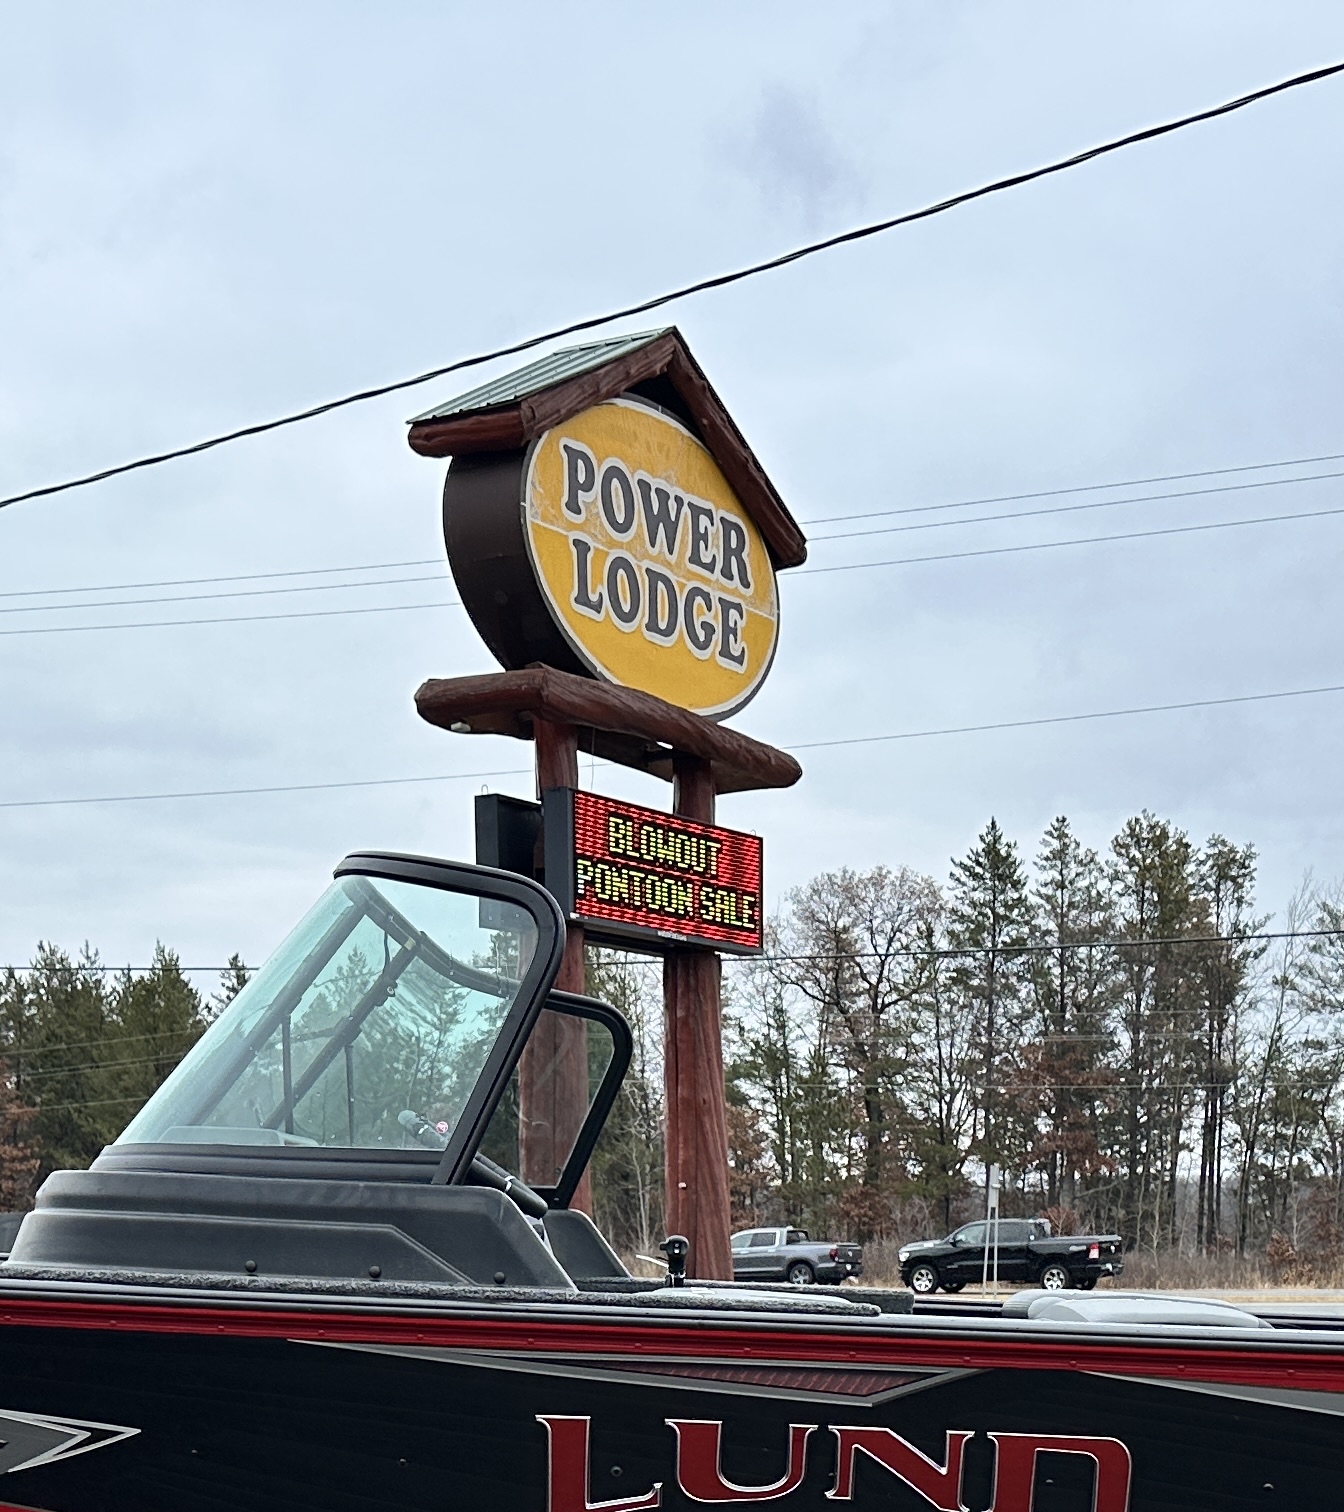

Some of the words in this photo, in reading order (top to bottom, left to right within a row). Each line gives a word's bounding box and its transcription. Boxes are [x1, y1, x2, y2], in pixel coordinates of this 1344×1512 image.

[562, 443, 752, 590] POWER
[572, 538, 746, 667] LODGE
[576, 859, 694, 917] PONTOON
[700, 886, 756, 929] SALE
[609, 816, 721, 875] BLOWOUT
